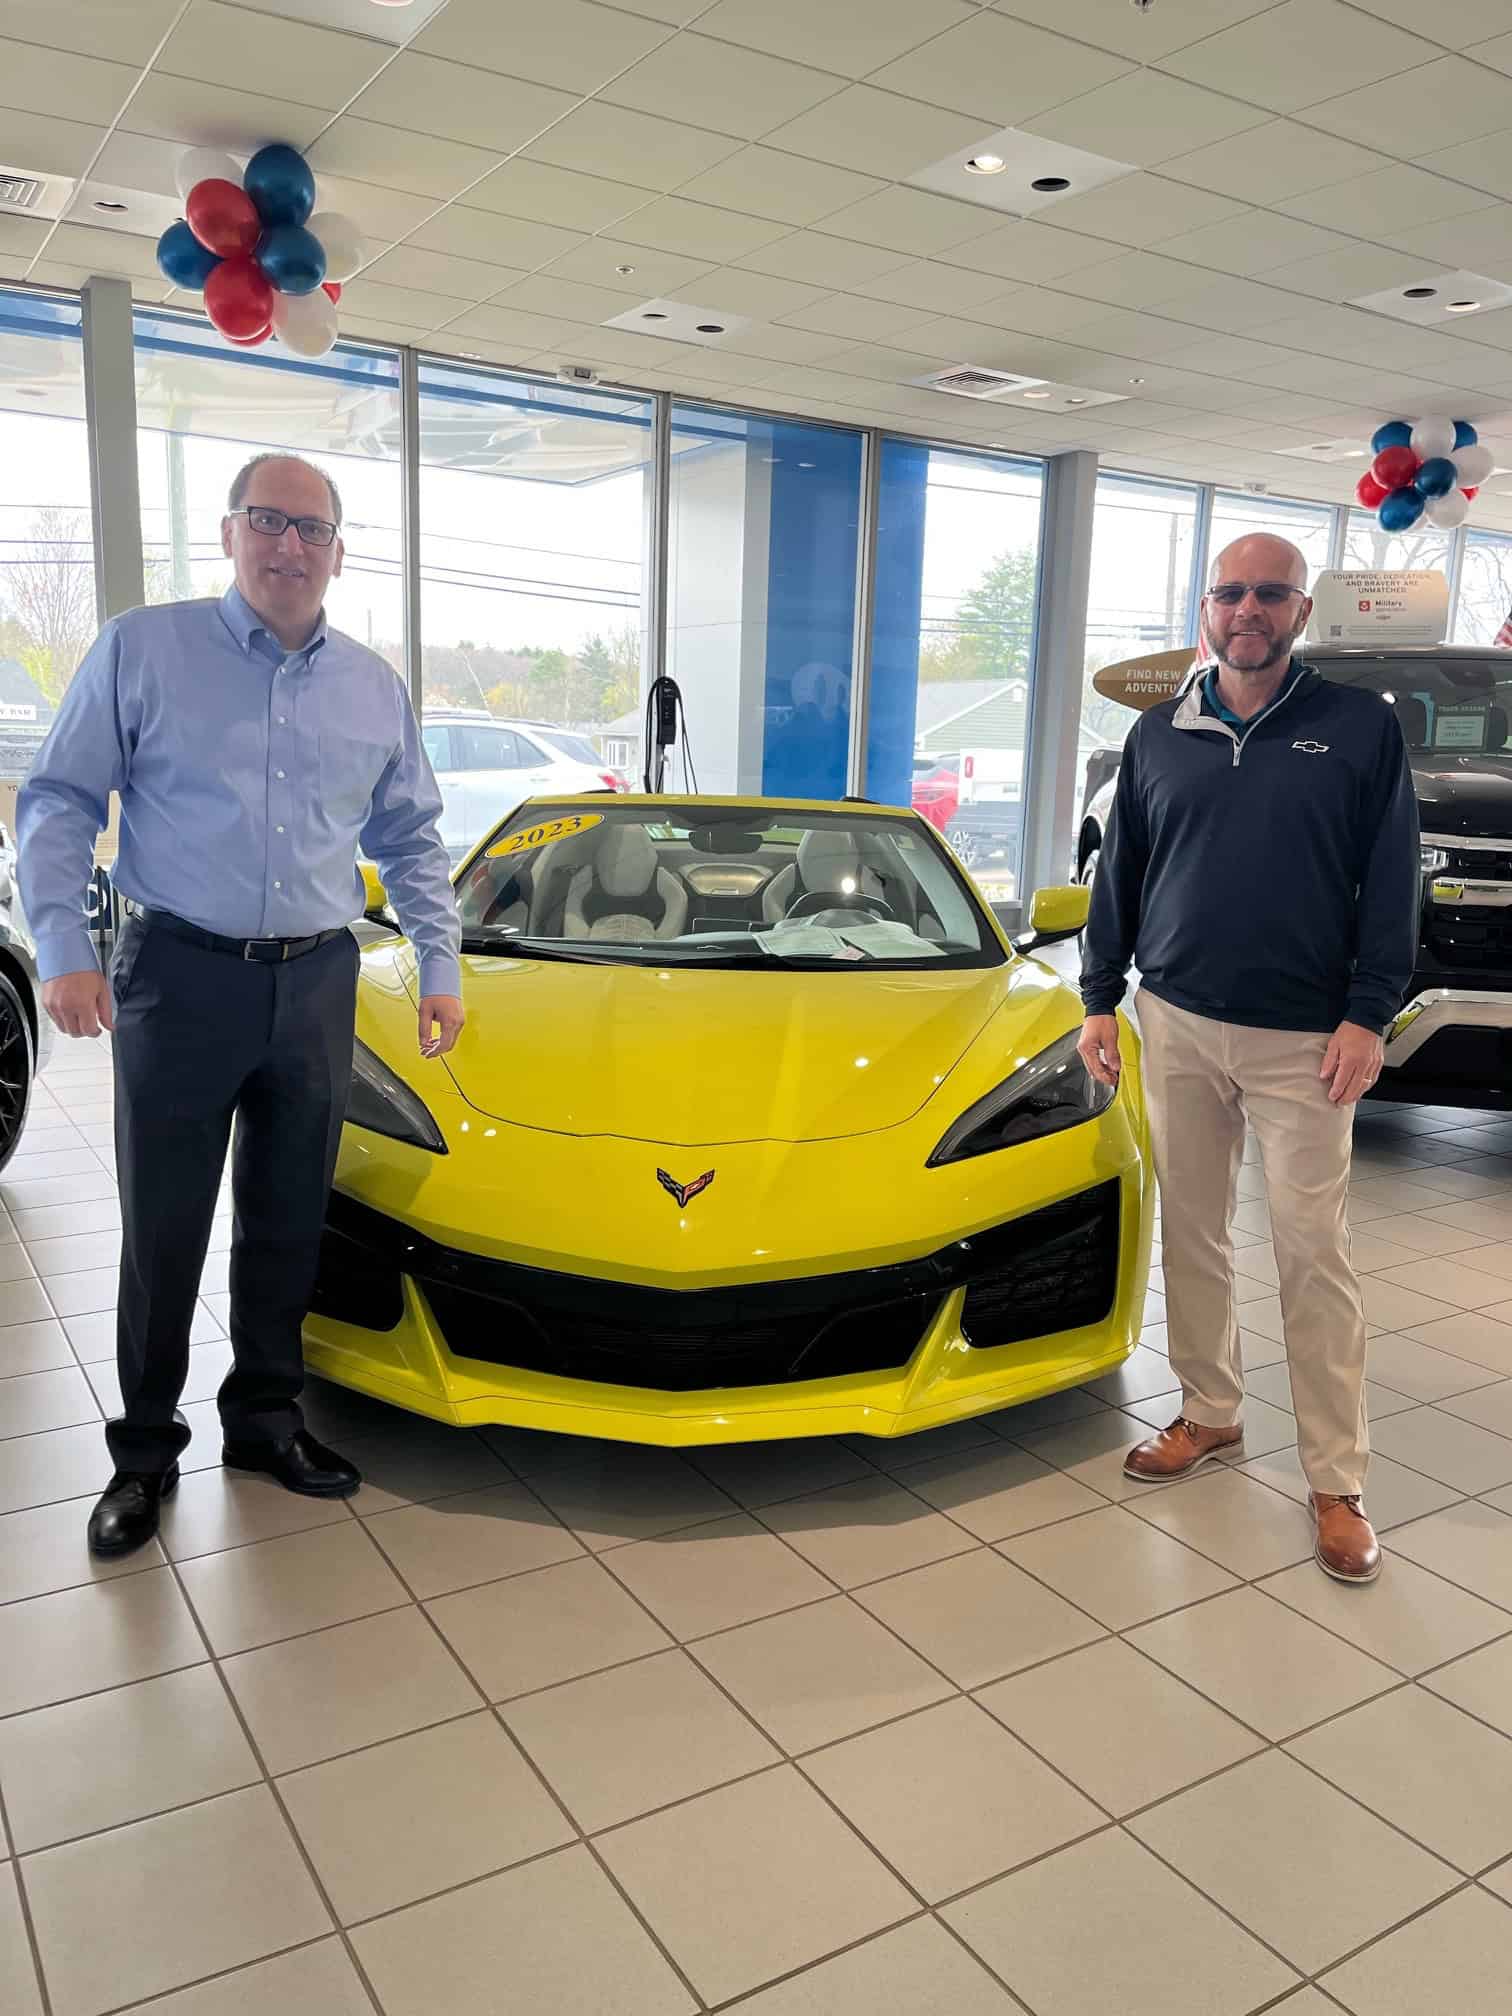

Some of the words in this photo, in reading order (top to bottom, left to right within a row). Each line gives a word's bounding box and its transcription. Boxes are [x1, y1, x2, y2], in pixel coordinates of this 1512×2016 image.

[1126, 669, 1152, 680] FIND
[1155, 670, 1181, 680] NEW
[1124, 682, 1177, 693] ADVENTU
[509, 816, 582, 851] 2023
